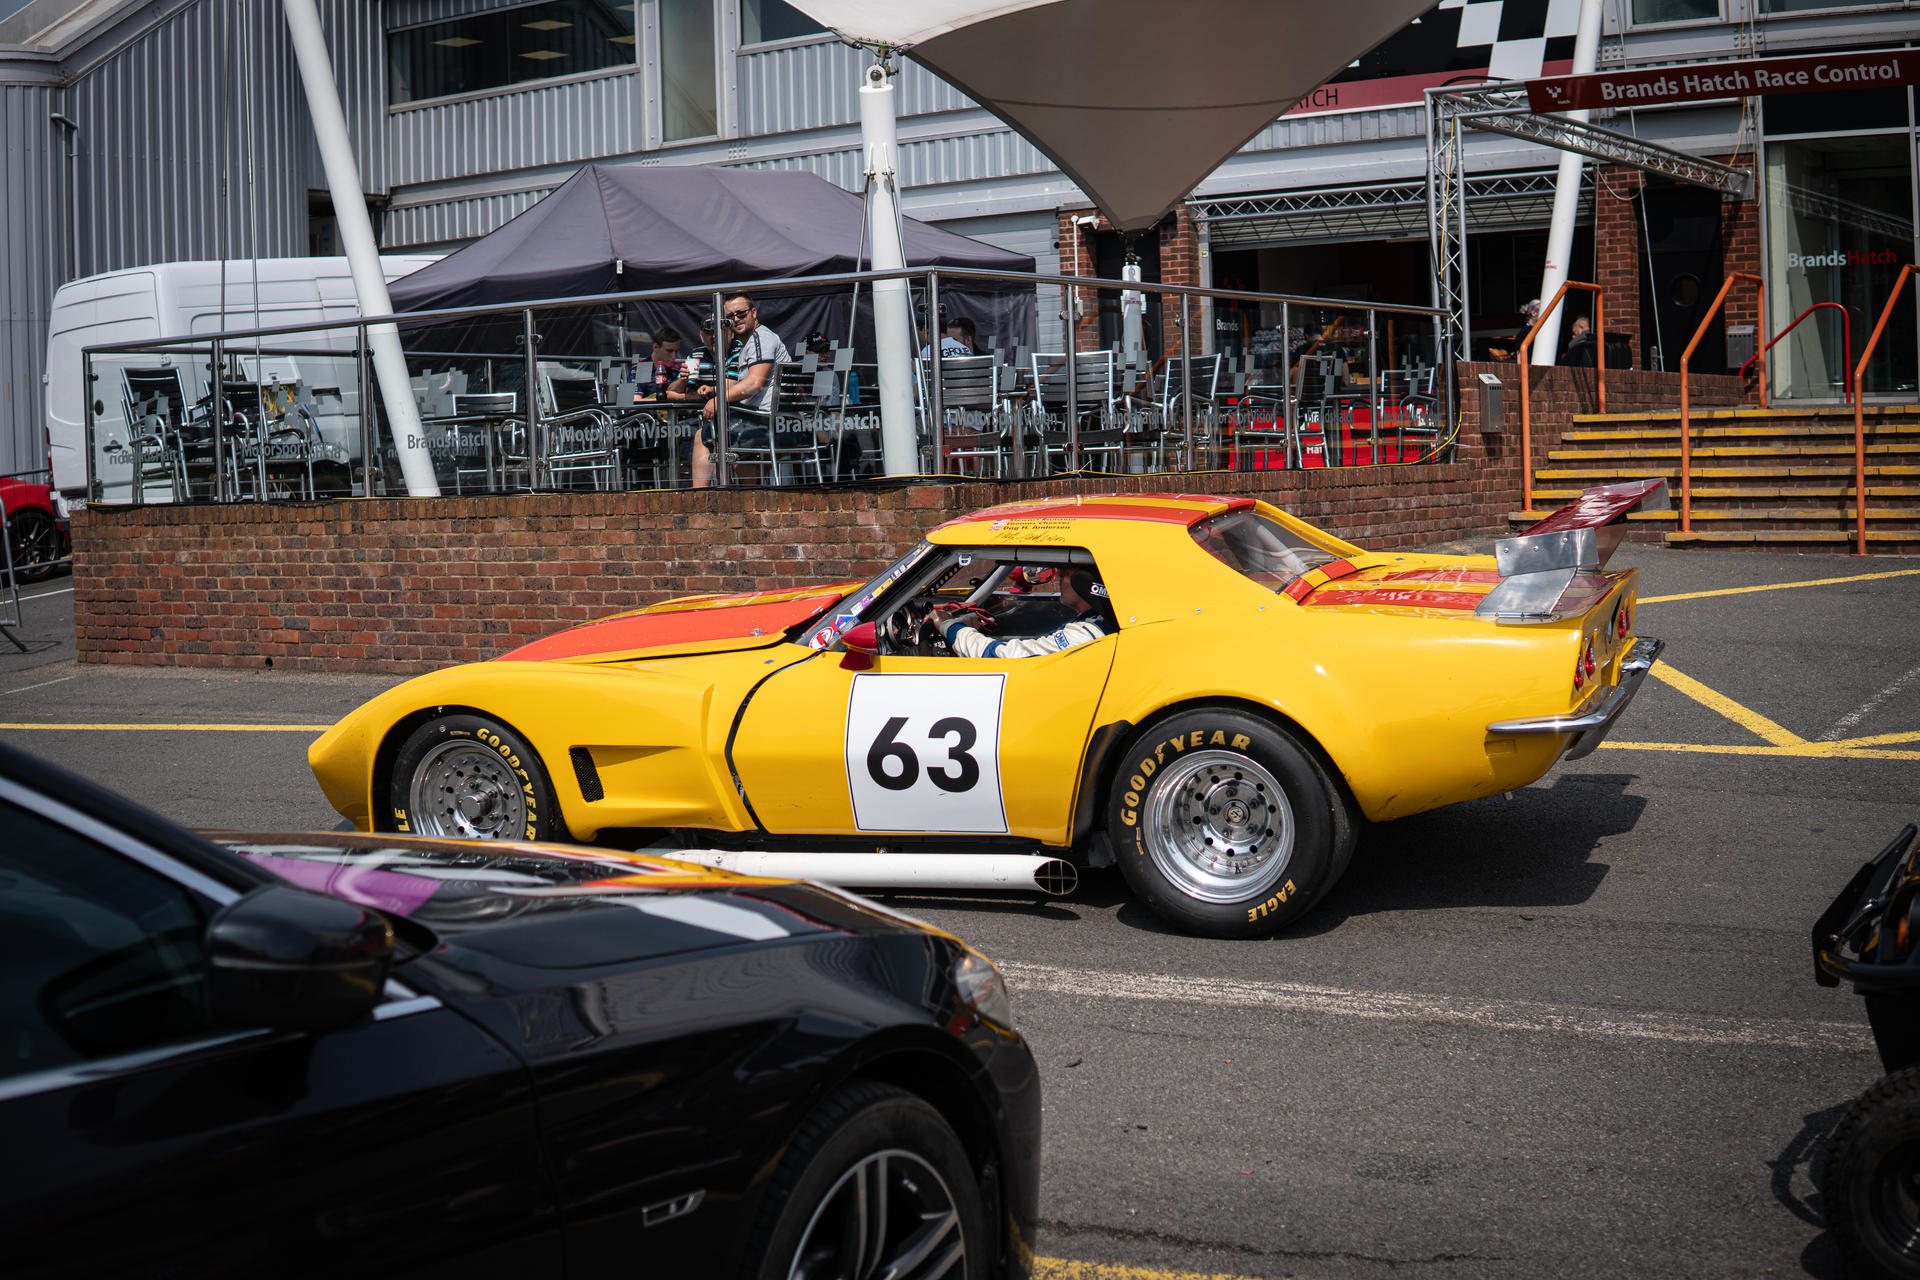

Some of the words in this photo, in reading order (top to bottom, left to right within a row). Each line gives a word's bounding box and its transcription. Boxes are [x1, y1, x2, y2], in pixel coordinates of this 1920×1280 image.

[1600, 76, 1679, 100] Brands
[1683, 70, 1750, 95] Hatch
[1754, 66, 1809, 89] Race
[1814, 59, 1901, 84] Control
[407, 429, 489, 450] BrandsHatch
[776, 410, 880, 433] BrandsHatch
[1091, 583, 1109, 598] OM
[1055, 632, 1068, 649] OMP
[867, 716, 980, 793] 63
[476, 728, 537, 841] GOODYEAR
[1120, 730, 1251, 827] GOODYEAR
[1247, 879, 1297, 922] EAGLE
